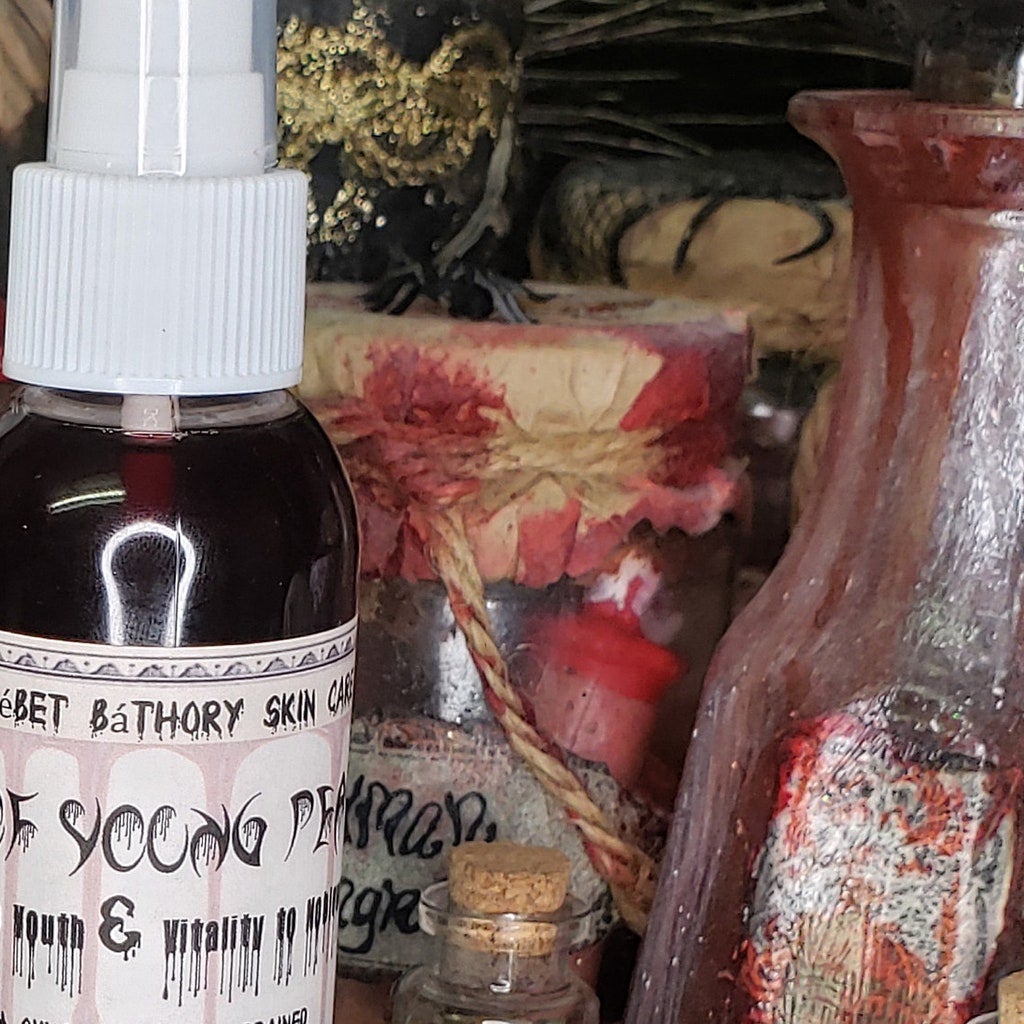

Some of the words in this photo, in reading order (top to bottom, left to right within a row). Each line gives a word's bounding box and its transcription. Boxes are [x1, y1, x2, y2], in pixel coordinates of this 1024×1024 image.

[91, 698, 245, 742] BáTHORY
[264, 687, 316, 734] SKIN
[59, 792, 268, 878] YOUNG
[98, 895, 142, 961] &
